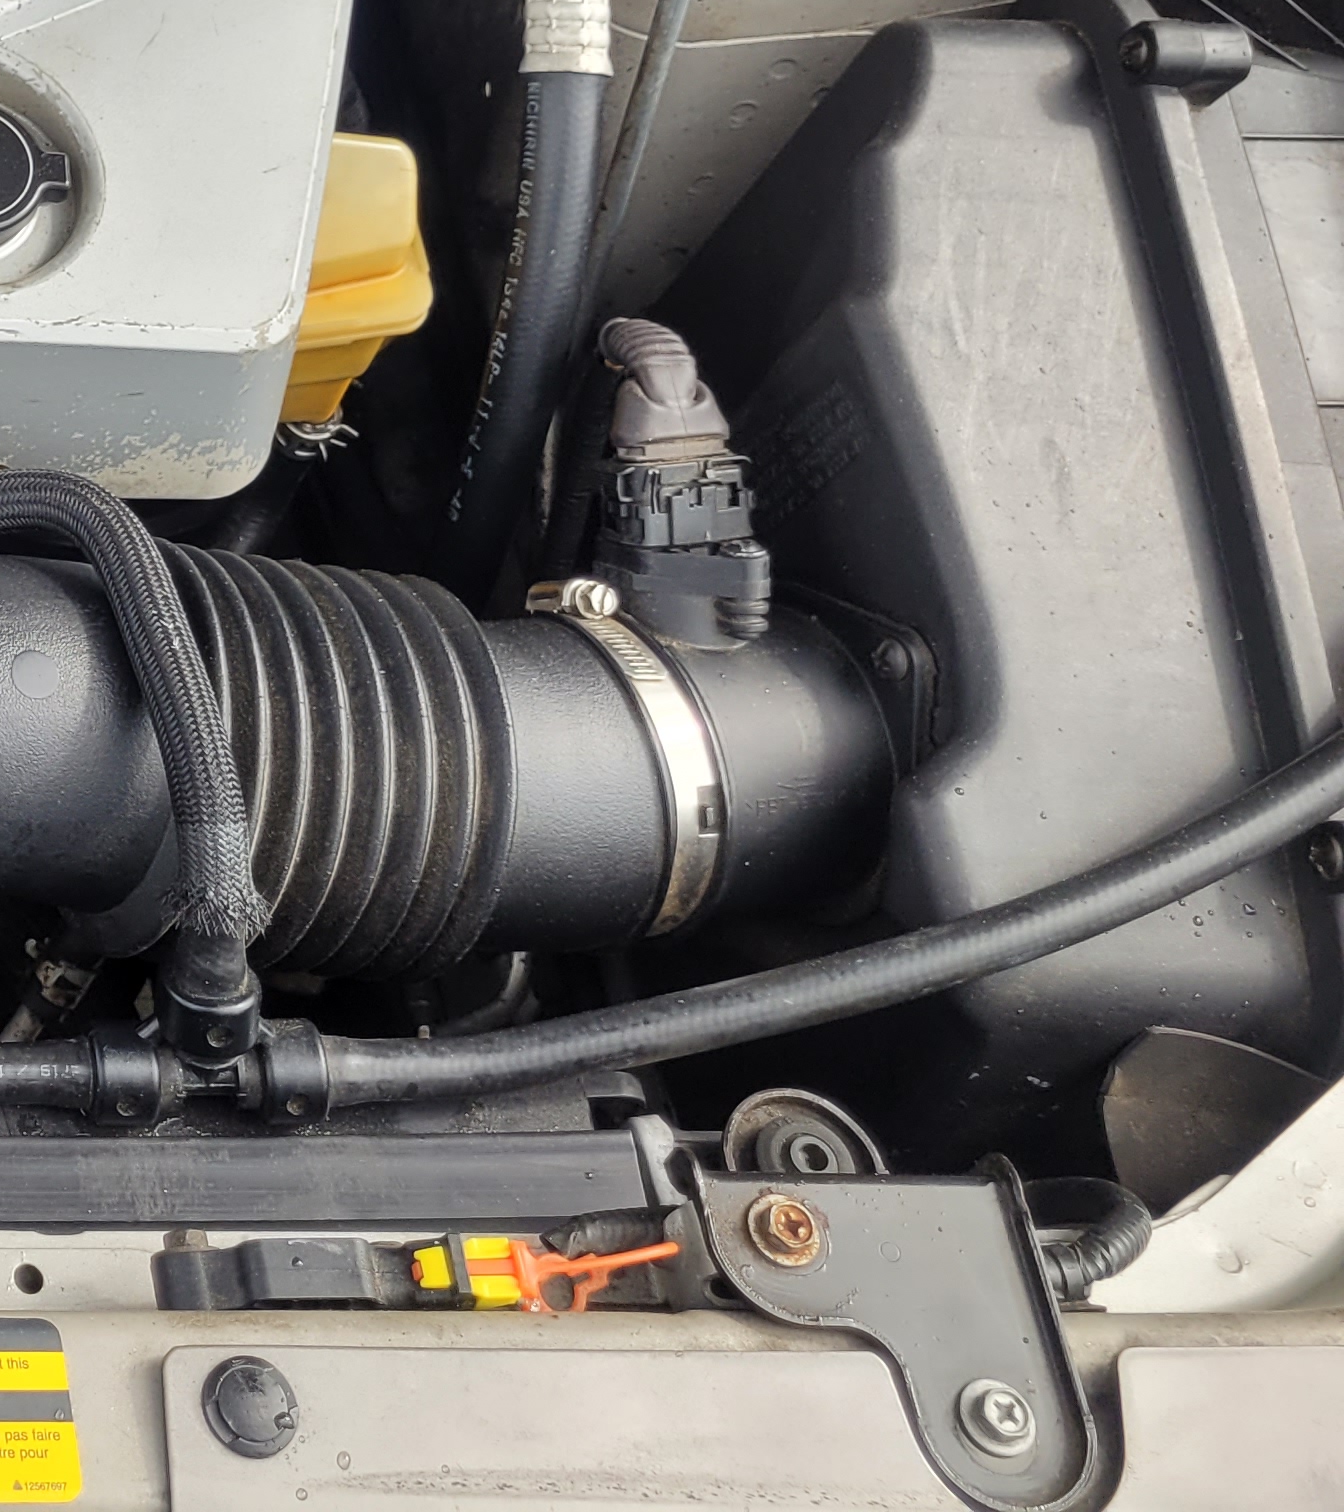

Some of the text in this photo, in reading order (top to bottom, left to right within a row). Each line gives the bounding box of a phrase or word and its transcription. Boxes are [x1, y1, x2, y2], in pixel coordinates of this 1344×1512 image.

[516, 179, 534, 219] USA
[7, 1358, 29, 1370] this
[4, 1431, 27, 1444] pas
[32, 1429, 60, 1441] faire
[19, 1449, 49, 1462] pour
[24, 1481, 67, 1491] 12567697
